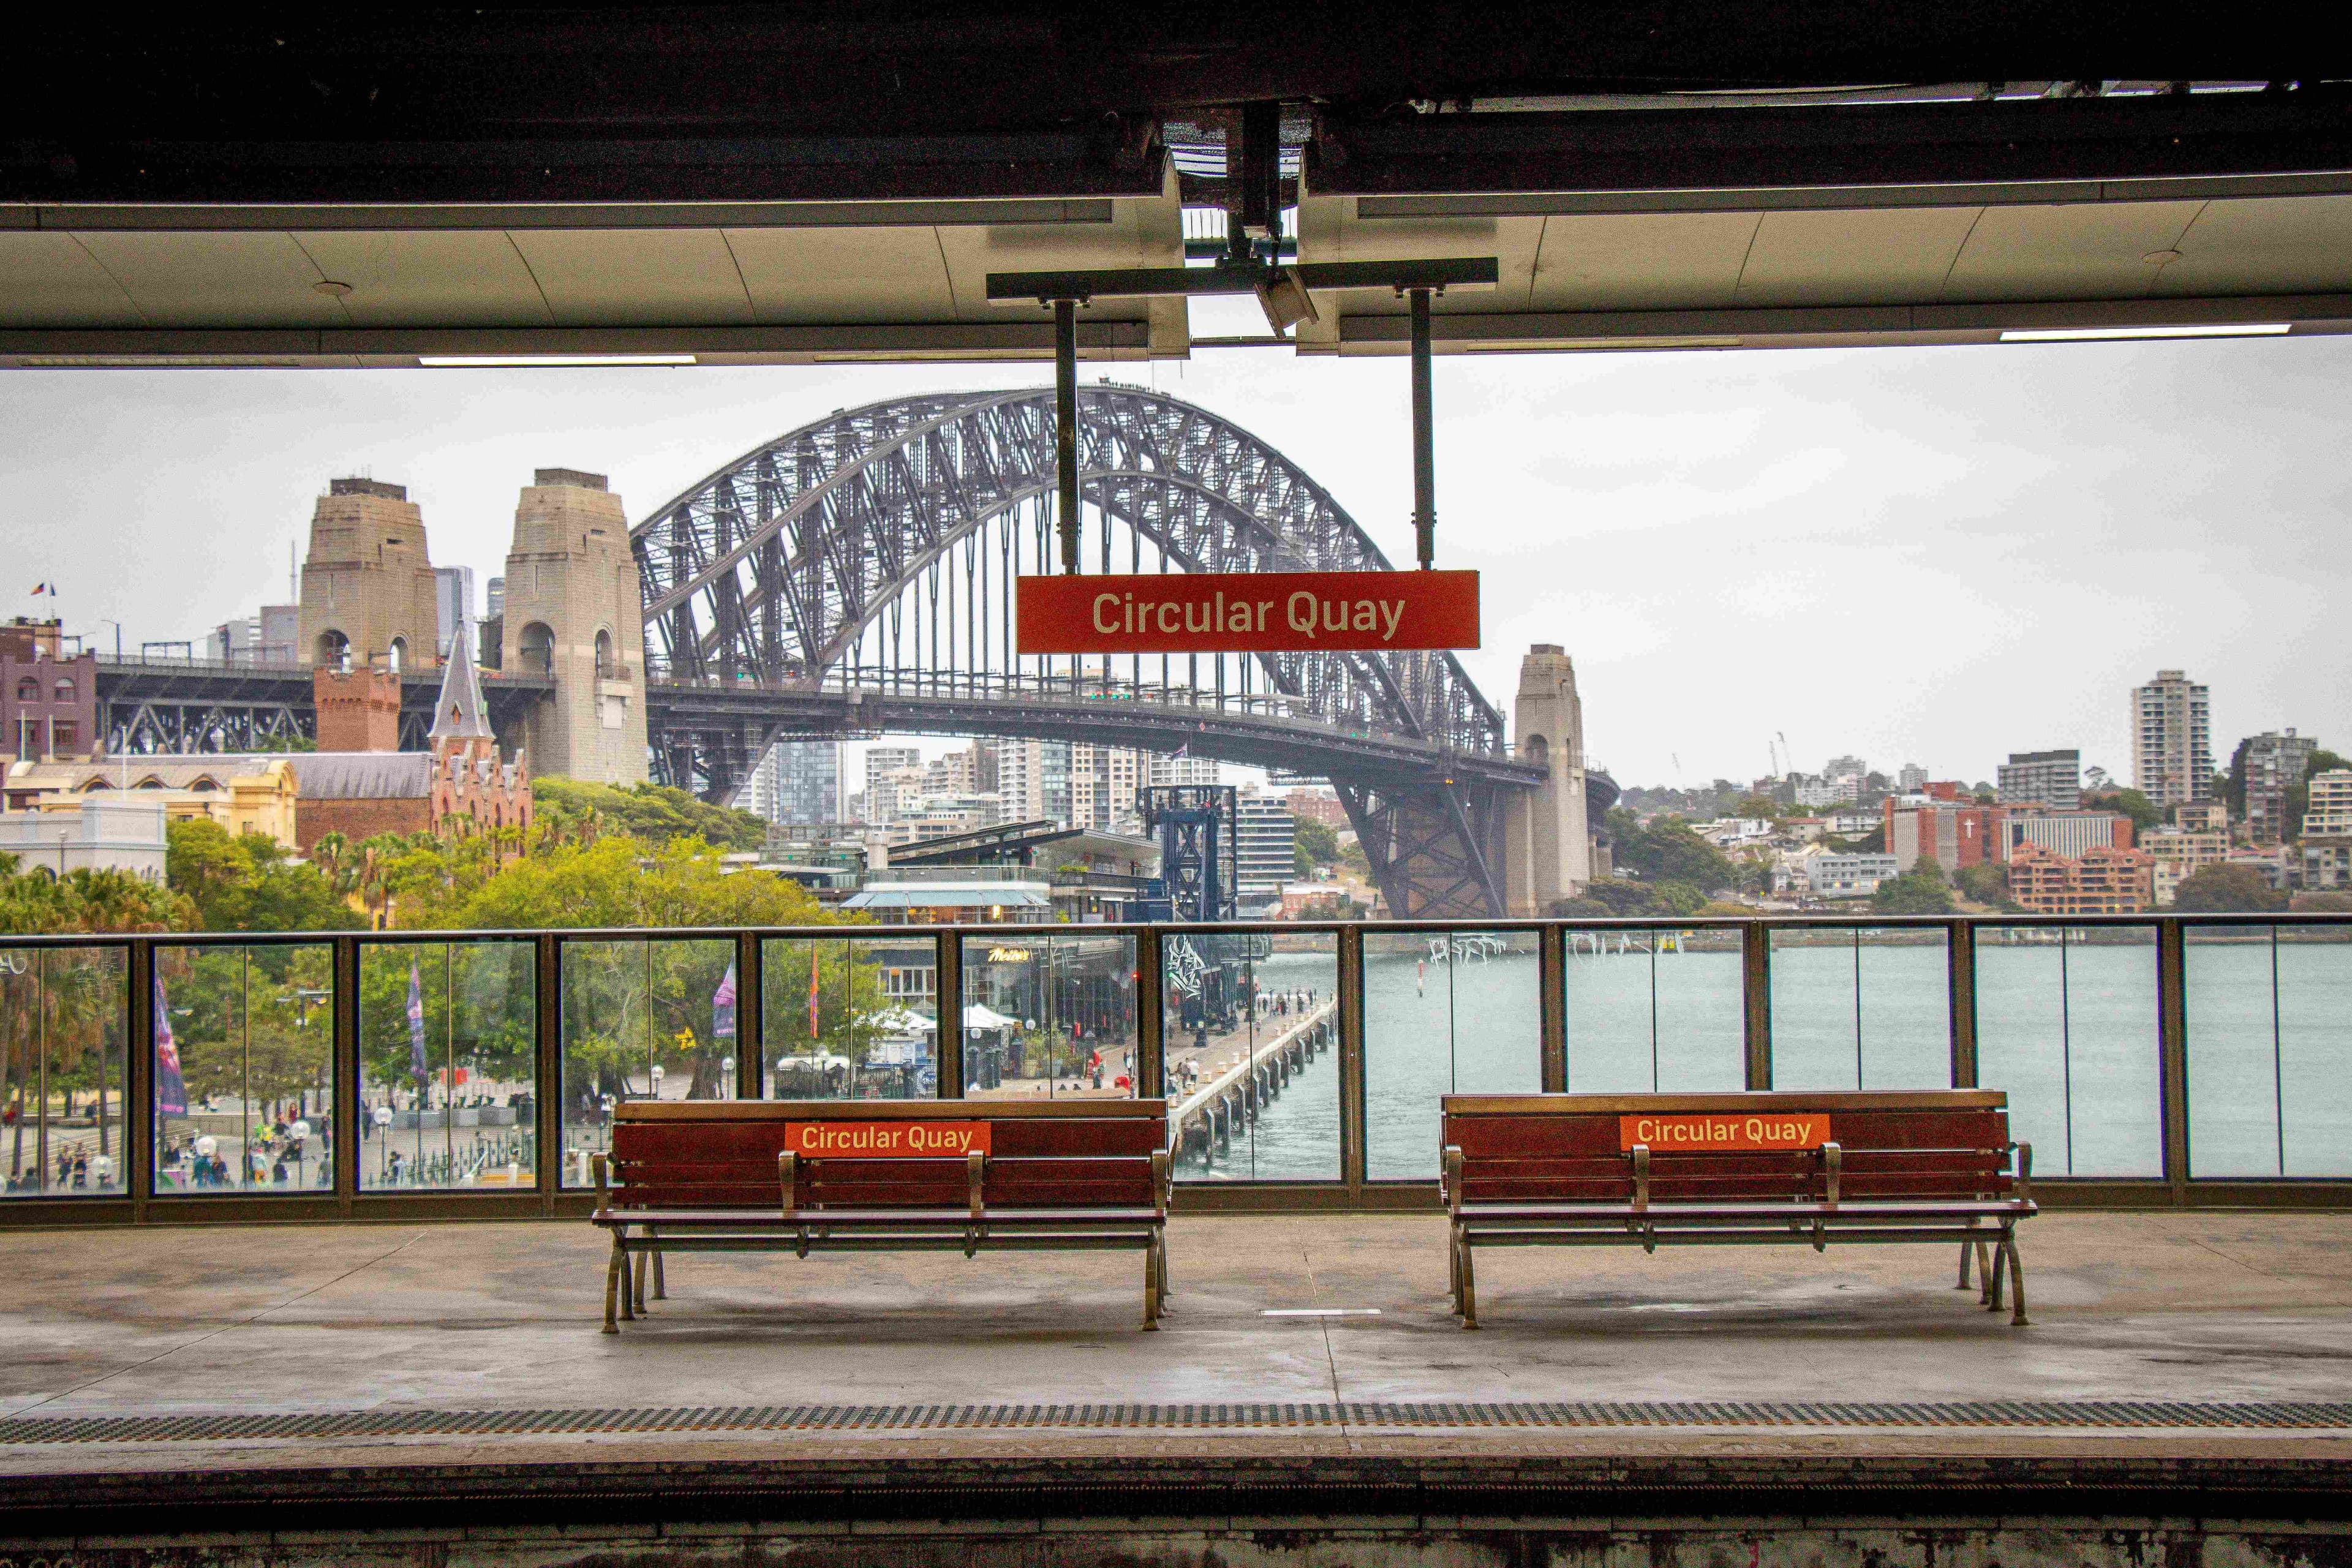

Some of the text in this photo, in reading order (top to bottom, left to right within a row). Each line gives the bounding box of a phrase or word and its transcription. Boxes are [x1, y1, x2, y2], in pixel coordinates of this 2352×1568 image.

[1093, 591, 1406, 641] Circular Quay
[802, 1126, 973, 1152] Circular Quay
[1637, 1118, 1811, 1144] Circular Quay
